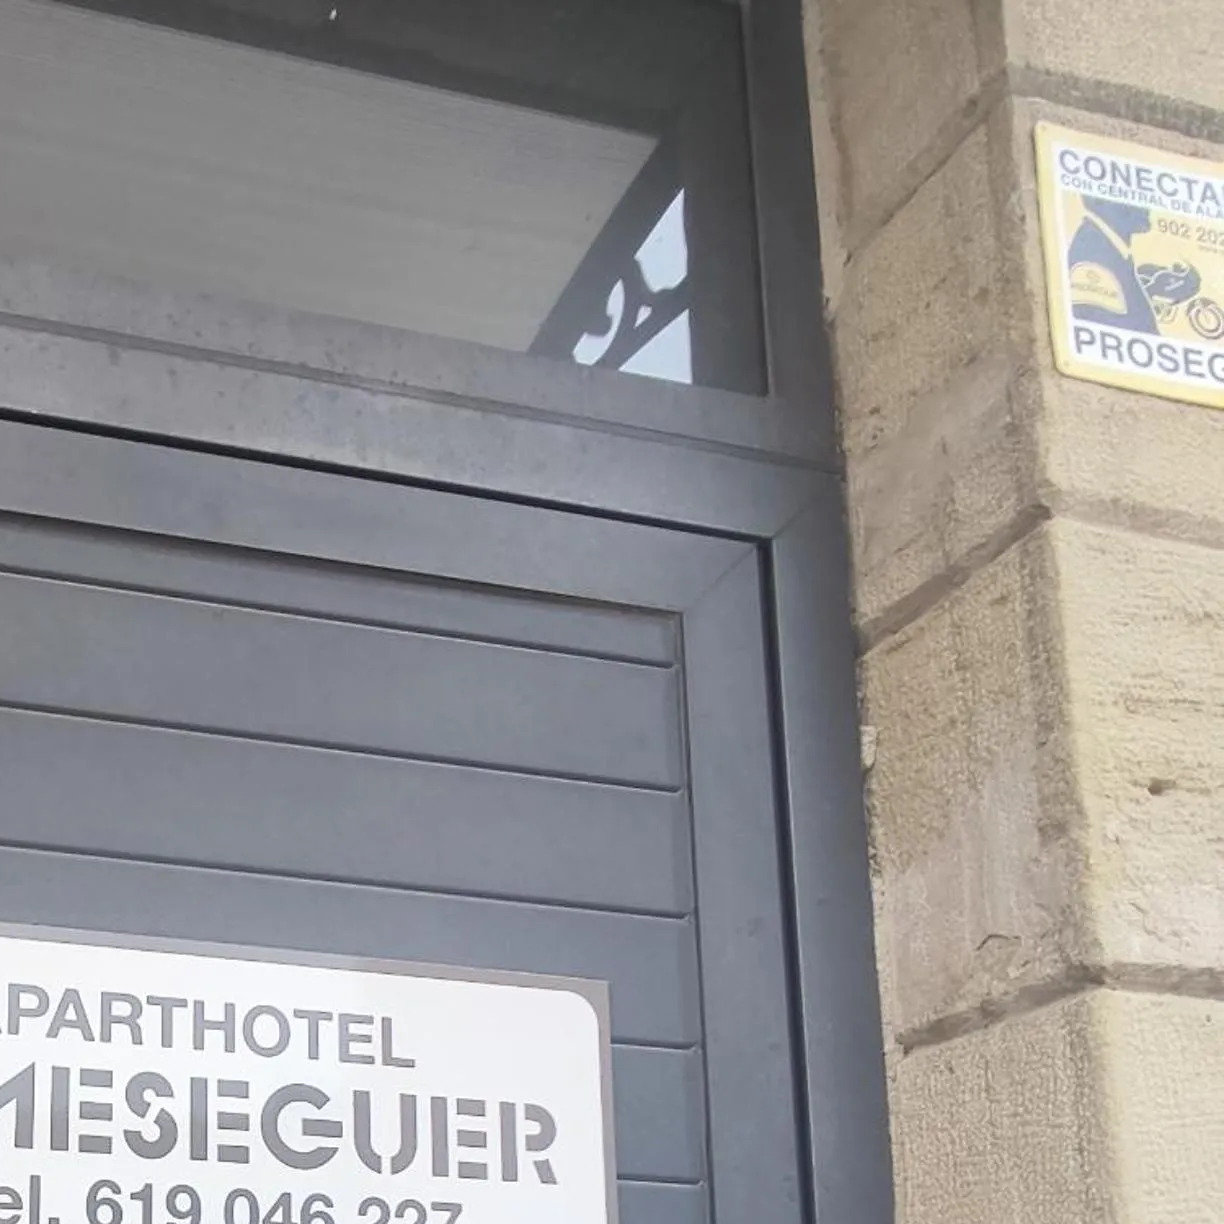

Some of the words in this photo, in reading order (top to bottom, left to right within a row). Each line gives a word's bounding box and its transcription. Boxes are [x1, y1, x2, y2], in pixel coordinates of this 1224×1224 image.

[1059, 148, 1224, 206] CONECTA
[1157, 217, 1191, 240] 902
[1073, 326, 1224, 383] PROSEG
